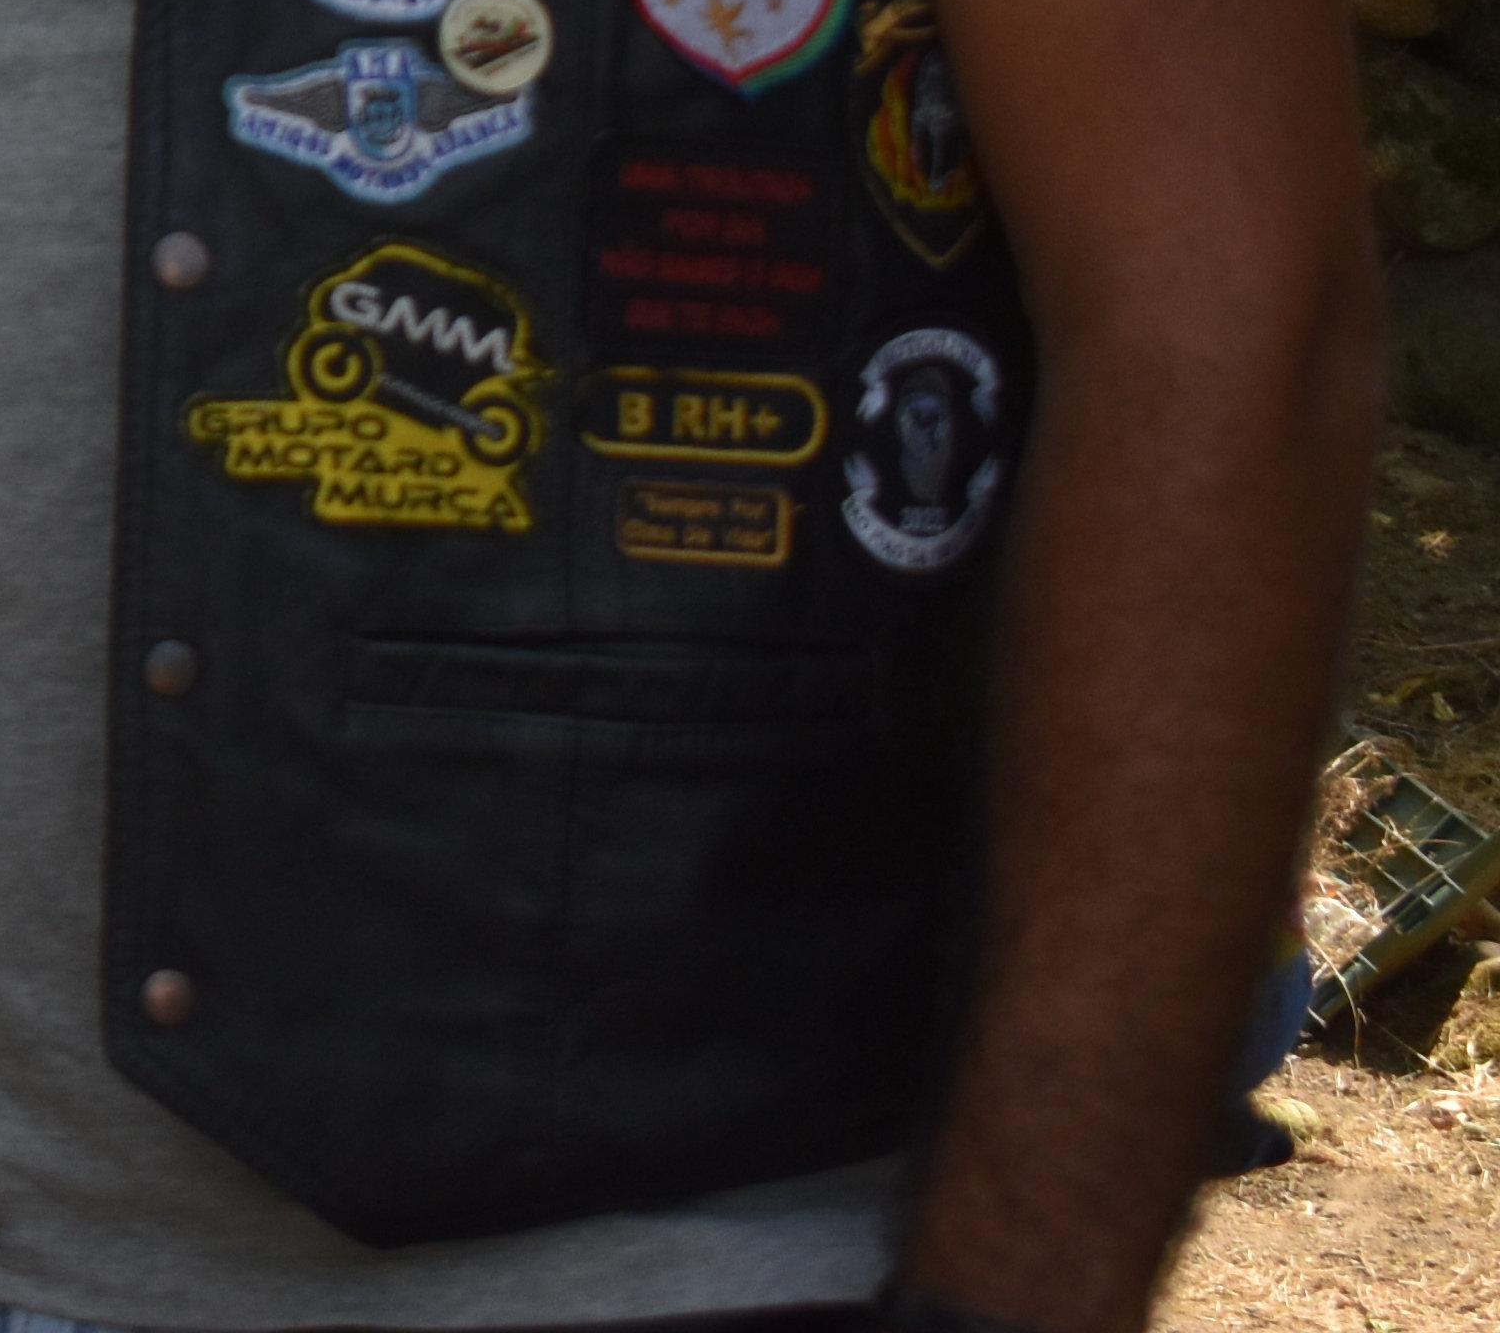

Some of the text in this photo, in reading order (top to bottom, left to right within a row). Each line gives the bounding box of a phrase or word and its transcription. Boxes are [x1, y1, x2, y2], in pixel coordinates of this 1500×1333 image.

[330, 281, 514, 373] GMM
[199, 406, 387, 440] GRUPO
[617, 391, 784, 443] B RH+
[235, 439, 461, 477] MOTARD
